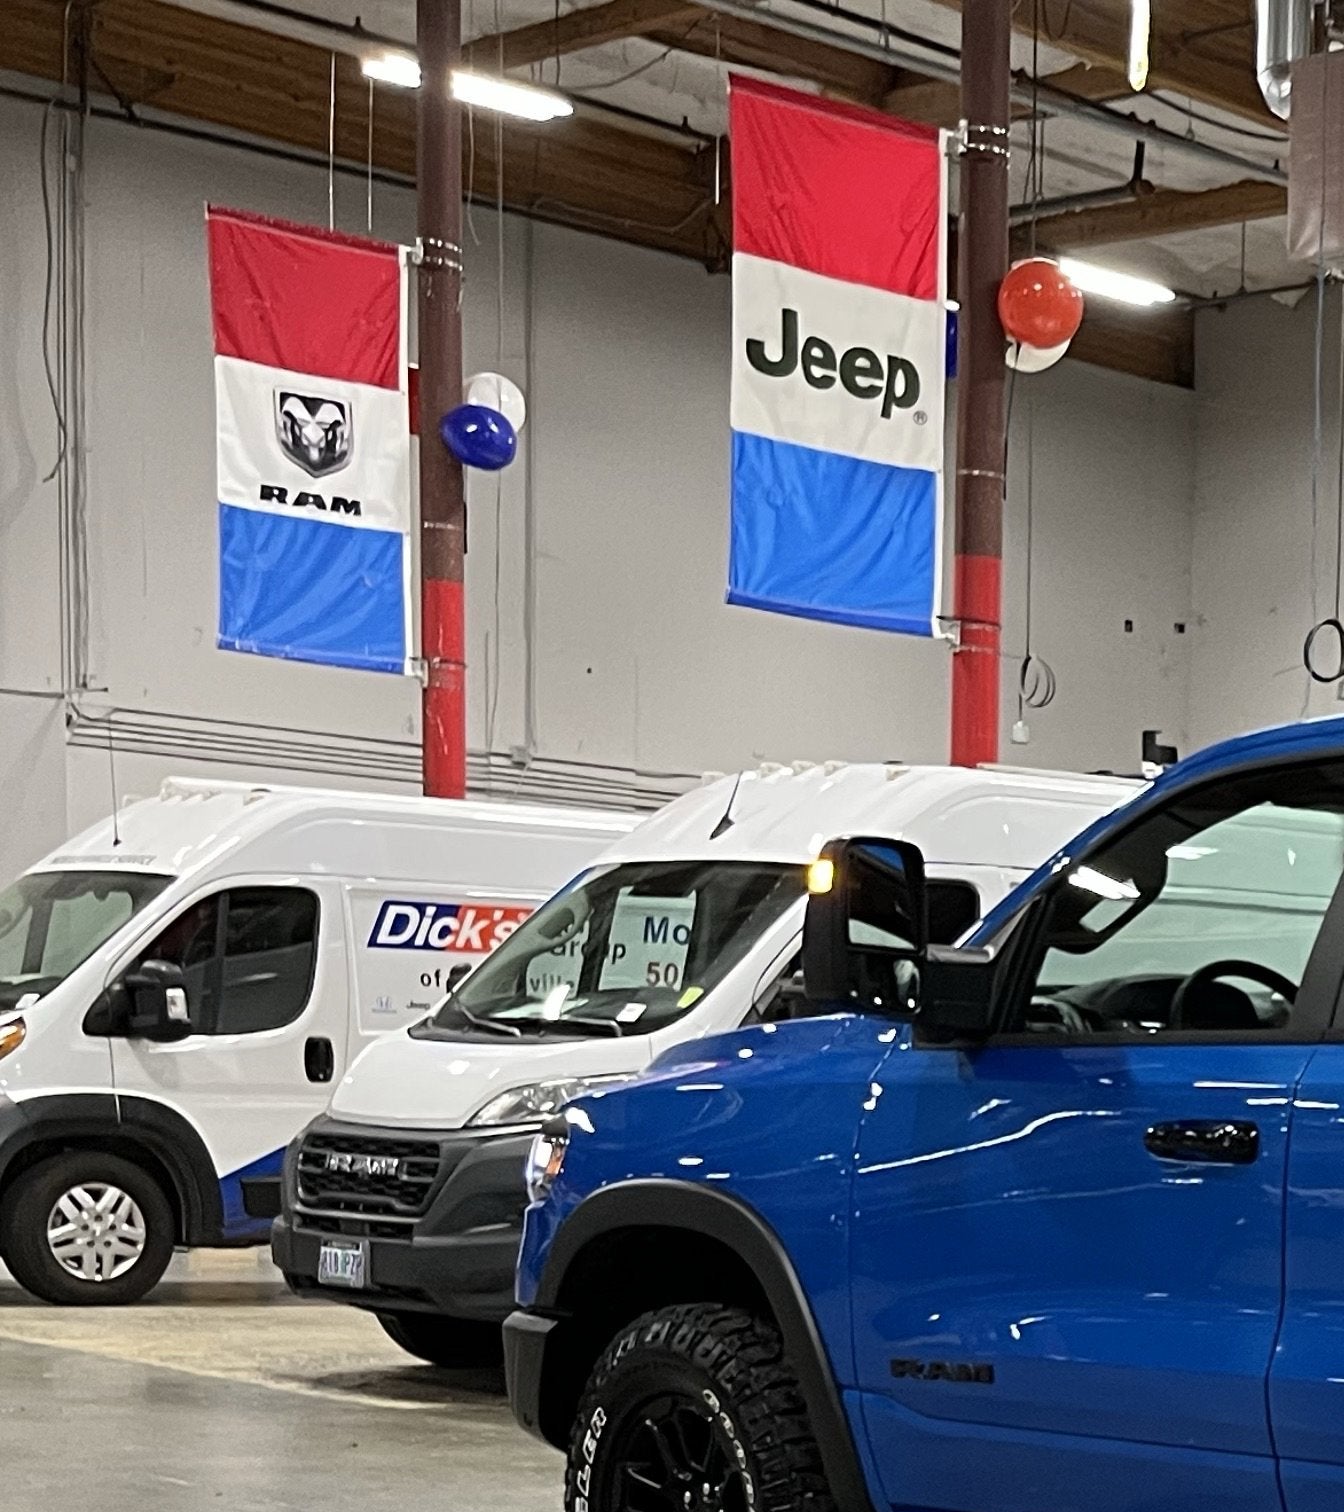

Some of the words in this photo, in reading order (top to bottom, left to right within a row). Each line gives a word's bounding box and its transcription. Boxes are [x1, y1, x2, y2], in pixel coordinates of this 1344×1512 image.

[745, 306, 921, 421] Jeep
[259, 484, 363, 518] RAM
[420, 969, 441, 987] of
